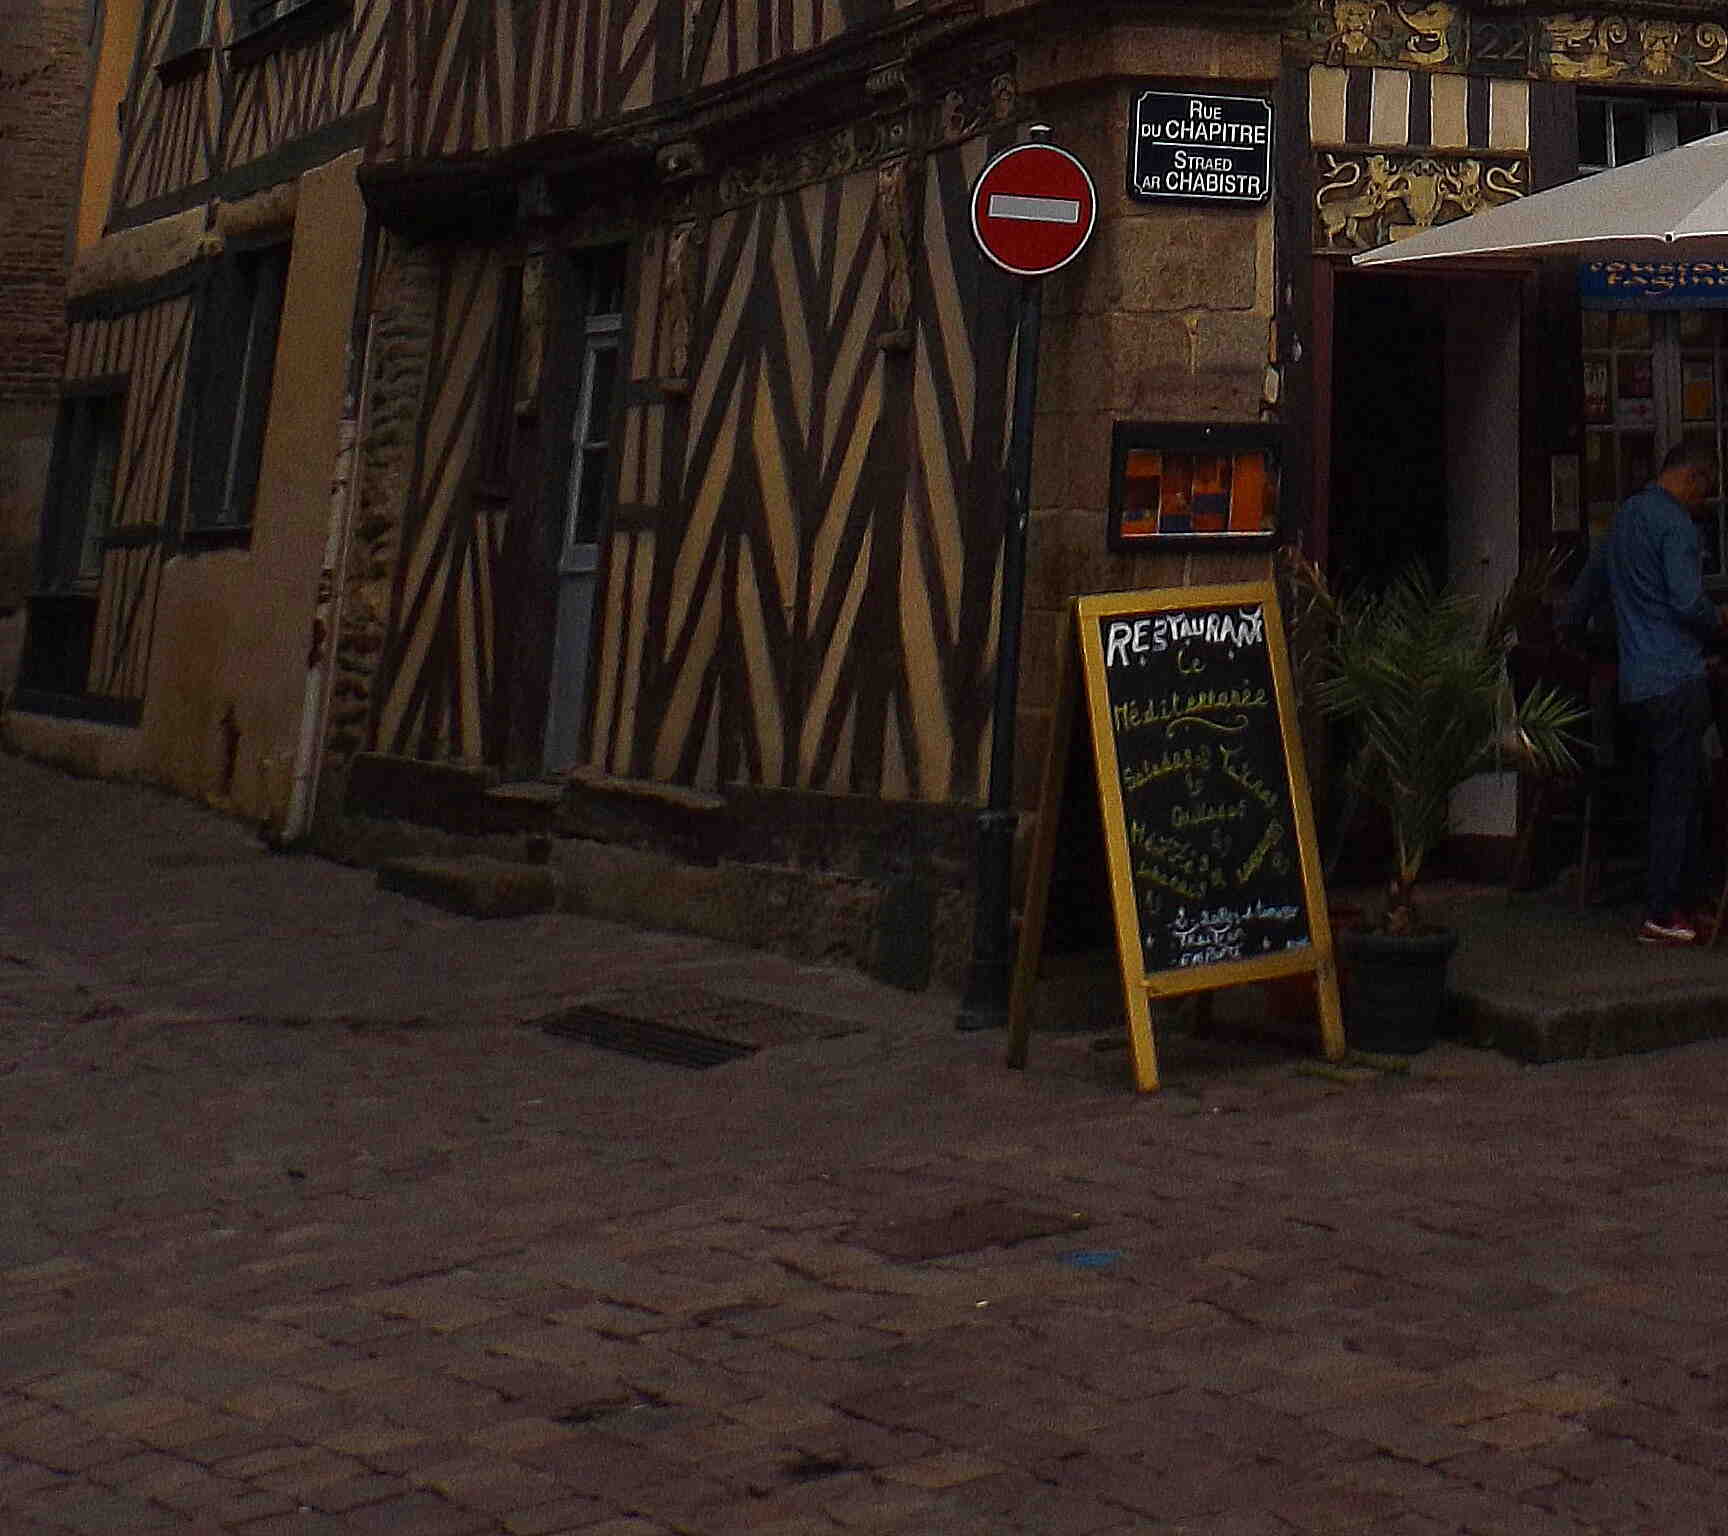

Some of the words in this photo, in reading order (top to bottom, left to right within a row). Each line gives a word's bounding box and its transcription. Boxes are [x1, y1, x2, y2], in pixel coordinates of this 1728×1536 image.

[1189, 99, 1223, 120] RUE
[1141, 123, 1162, 138] DU
[1165, 119, 1267, 144] CHAPITRE
[1174, 149, 1233, 172] STRAED
[1142, 175, 1161, 190] AR
[1165, 171, 1261, 195] CHABISTR
[1106, 606, 1264, 666] RESTAURANT
